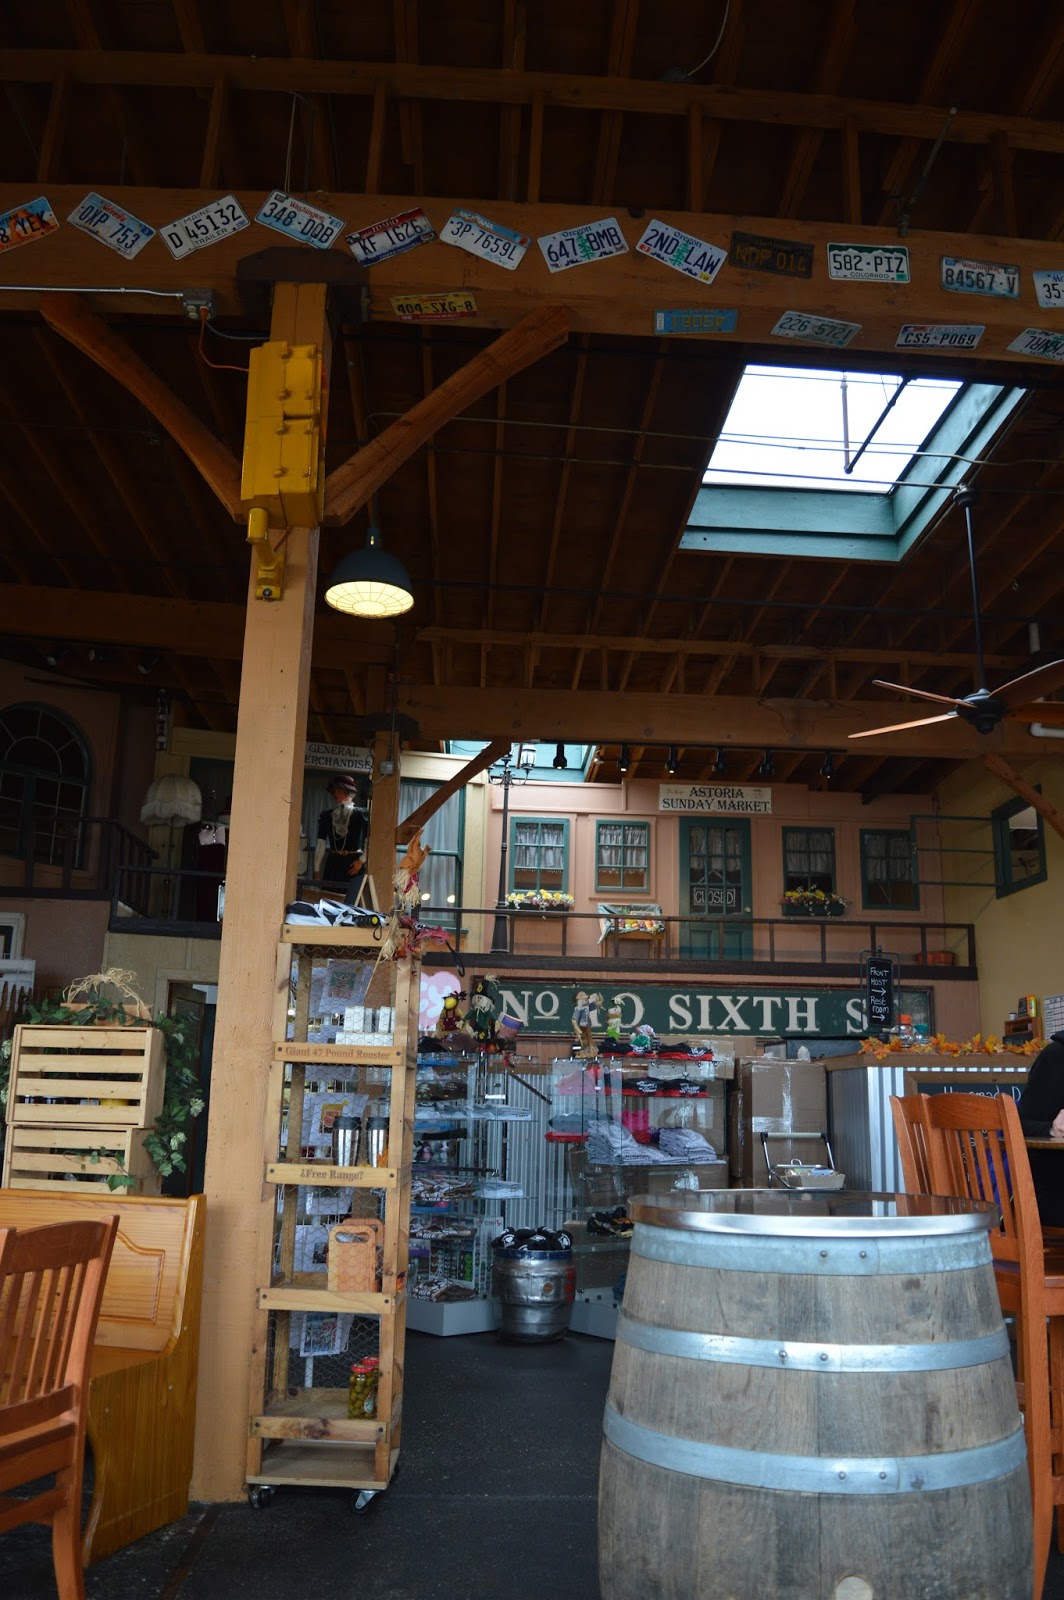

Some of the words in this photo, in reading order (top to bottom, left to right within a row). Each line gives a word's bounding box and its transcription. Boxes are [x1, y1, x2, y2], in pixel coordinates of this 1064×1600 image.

[183, 208, 212, 225] MAINE
[289, 201, 325, 223] Washington
[167, 232, 183, 249] D
[184, 204, 242, 240] 45132
[370, 218, 400, 233] IDAHO
[562, 225, 592, 238] Oregon
[109, 222, 141, 249] 753
[194, 228, 229, 246] TRAILER
[673, 231, 702, 248] Oregon
[547, 238, 578, 263] 647
[586, 227, 622, 252] BMB
[643, 228, 680, 255] 2ND
[683, 246, 721, 275] LAW
[849, 271, 890, 279] COLORADO
[779, 317, 811, 332] 226
[815, 323, 853, 340] 5721
[904, 332, 931, 344] CS5
[308, 743, 359, 757] GENERAL
[304, 754, 371, 770] ERCHANDISE
[689, 786, 745, 799] ASTORIA
[662, 798, 714, 810] SUNDAY
[717, 800, 770, 812] MARKET
[668, 993, 821, 1033] SIXTH
[286, 1046, 310, 1056] Giant
[325, 1049, 354, 1058] Pound
[356, 1050, 391, 1060] Rooster
[329, 1170, 364, 1182] Range?
